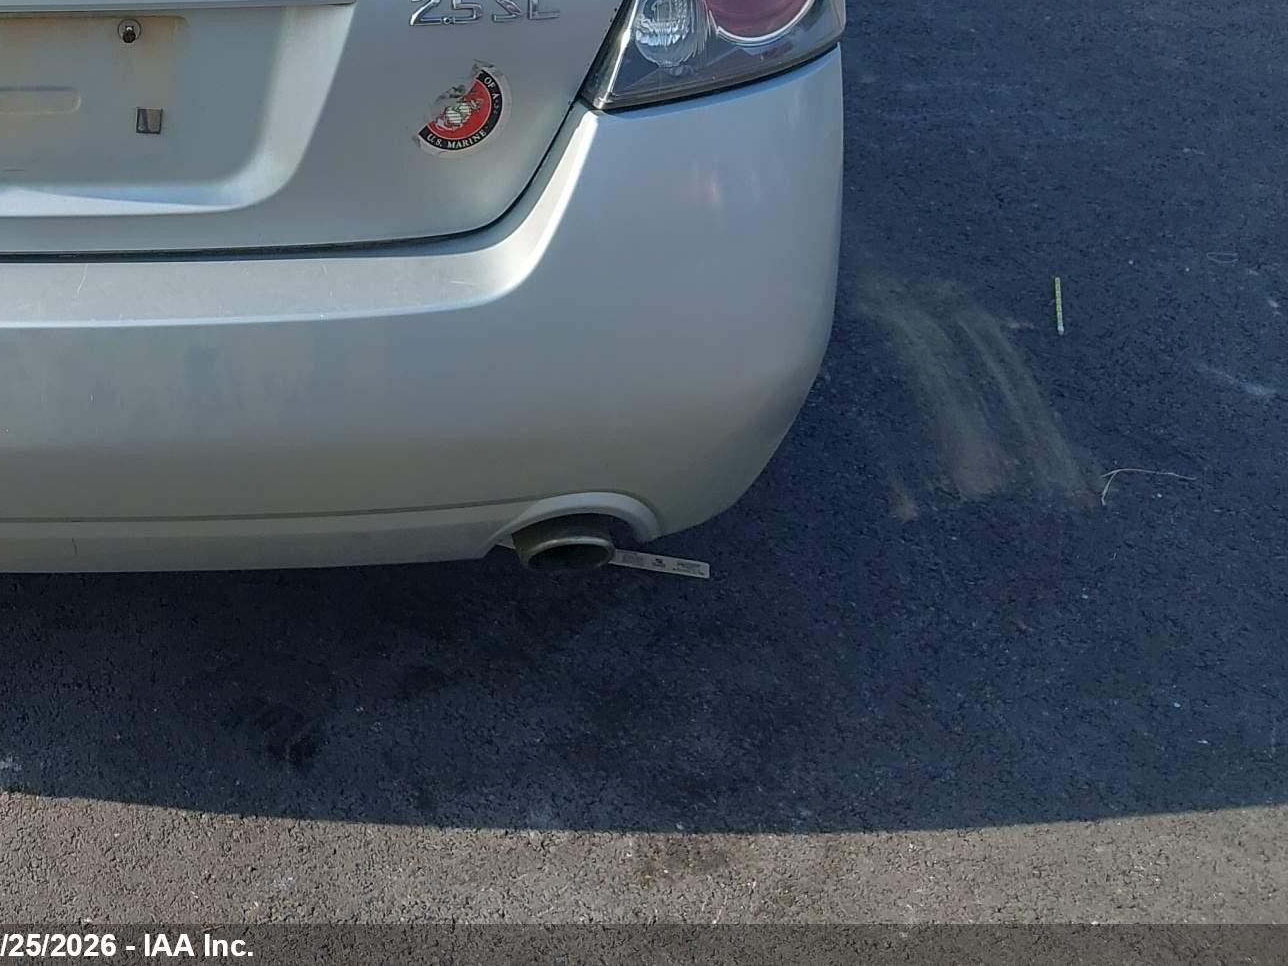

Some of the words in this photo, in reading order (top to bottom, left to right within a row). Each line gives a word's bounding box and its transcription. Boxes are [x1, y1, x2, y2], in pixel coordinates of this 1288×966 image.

[484, 76, 496, 89] OF
[426, 133, 443, 147] U.S.
[447, 129, 487, 149] MARINE
